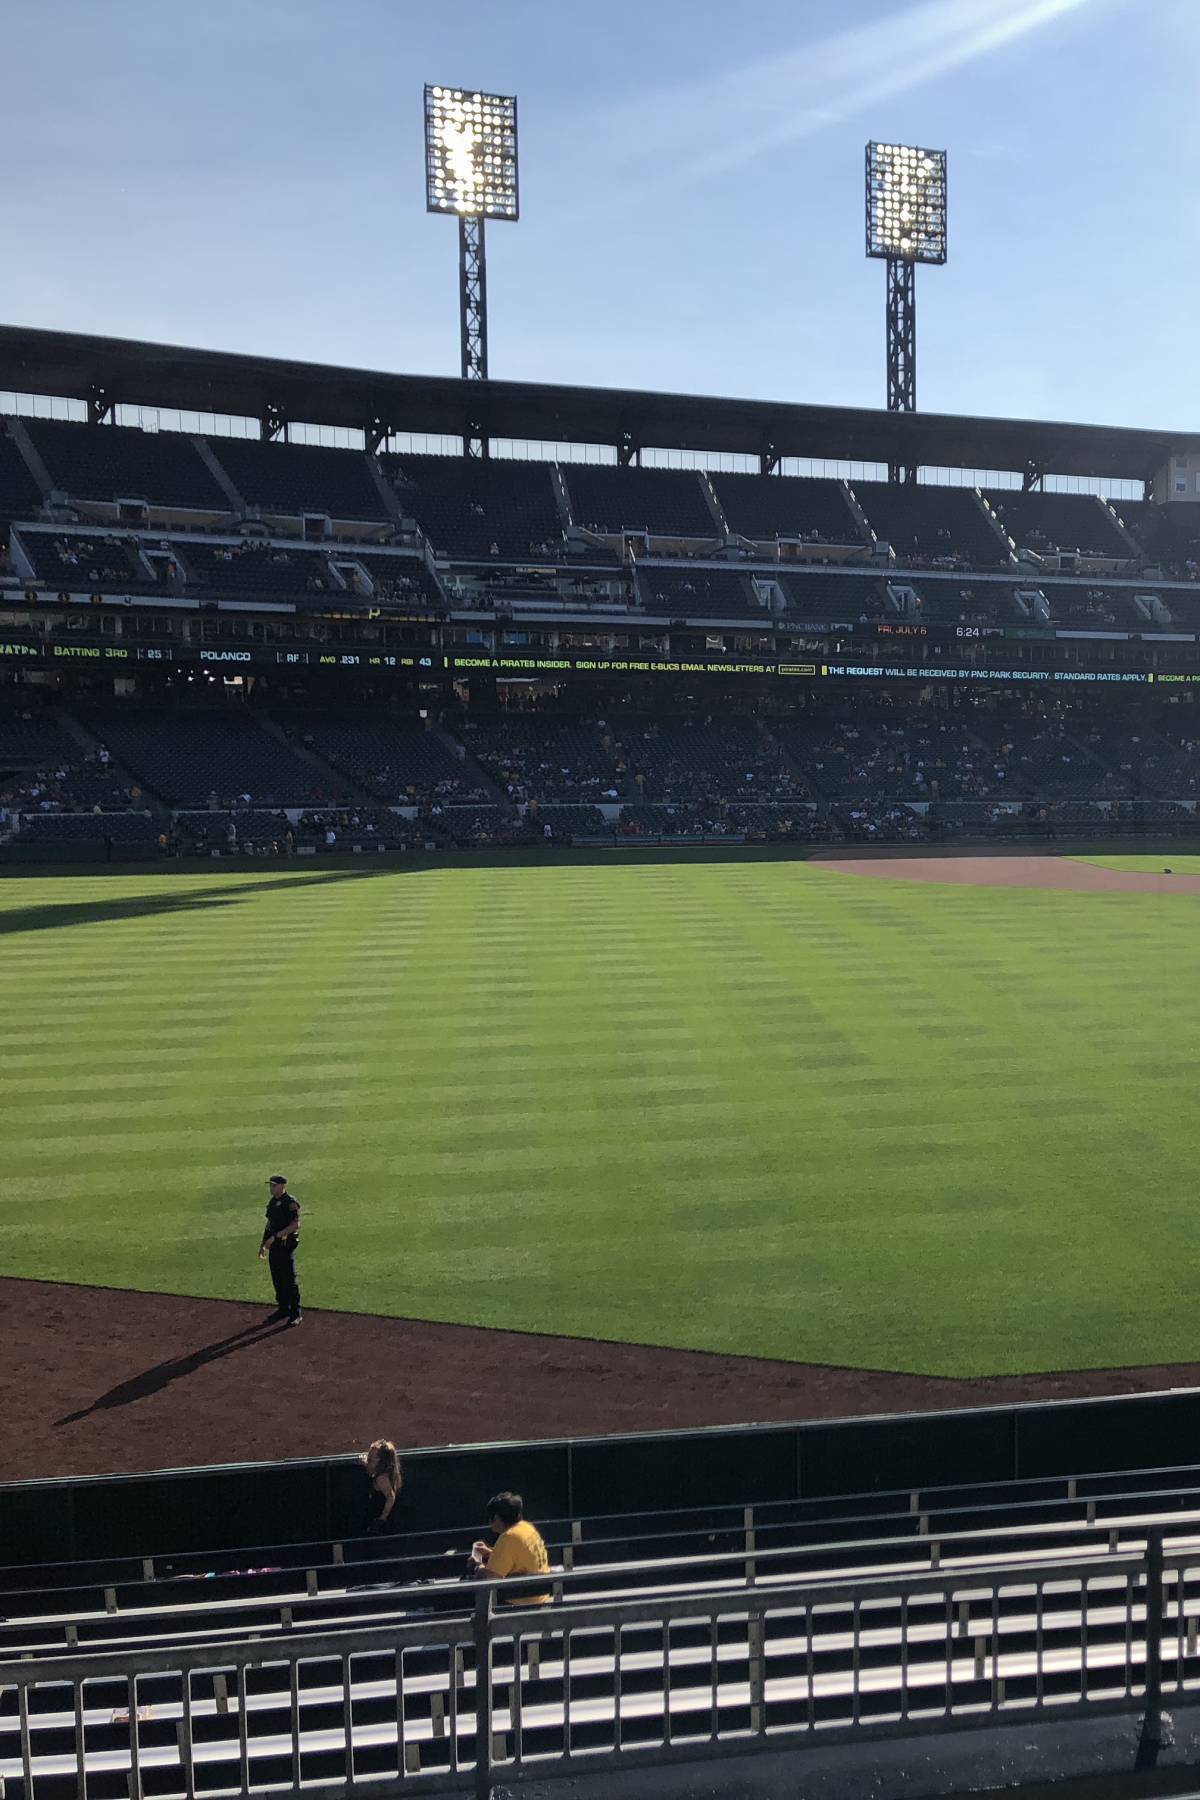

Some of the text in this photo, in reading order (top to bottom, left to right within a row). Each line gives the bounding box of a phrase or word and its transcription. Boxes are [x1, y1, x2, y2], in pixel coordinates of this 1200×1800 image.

[895, 625, 918, 634] JULY
[920, 626, 927, 636] 6
[956, 627, 980, 636] 6:24
[54, 646, 128, 658] BATTING 3RD
[147, 650, 162, 659] 25
[200, 651, 251, 661] POLANCO
[286, 654, 300, 663] RF
[319, 656, 336, 664] AVG
[340, 656, 360, 664] .231
[384, 656, 396, 665] 12
[419, 656, 432, 666] 43
[454, 658, 490, 666] BECOME
[492, 658, 498, 667] A
[500, 659, 536, 668] PIRATES
[536, 660, 572, 668] INSIDER.
[576, 660, 596, 669] SIGN
[598, 661, 610, 669] UP
[650, 663, 680, 671] E-BUCS
[681, 664, 706, 672] EMAIL
[707, 664, 764, 672] NEWSLETTERS
[828, 666, 844, 674] THE
[846, 667, 884, 676] REQUEST
[885, 668, 906, 676] WILL
[907, 668, 918, 676] BE
[919, 669, 957, 677] RECEIVED
[971, 670, 988, 678] PNC
[990, 671, 1011, 679] PARK
[1012, 672, 1050, 680] SECURITY.
[1054, 672, 1096, 680] STANDARD
[1122, 674, 1146, 682] APPLY.
